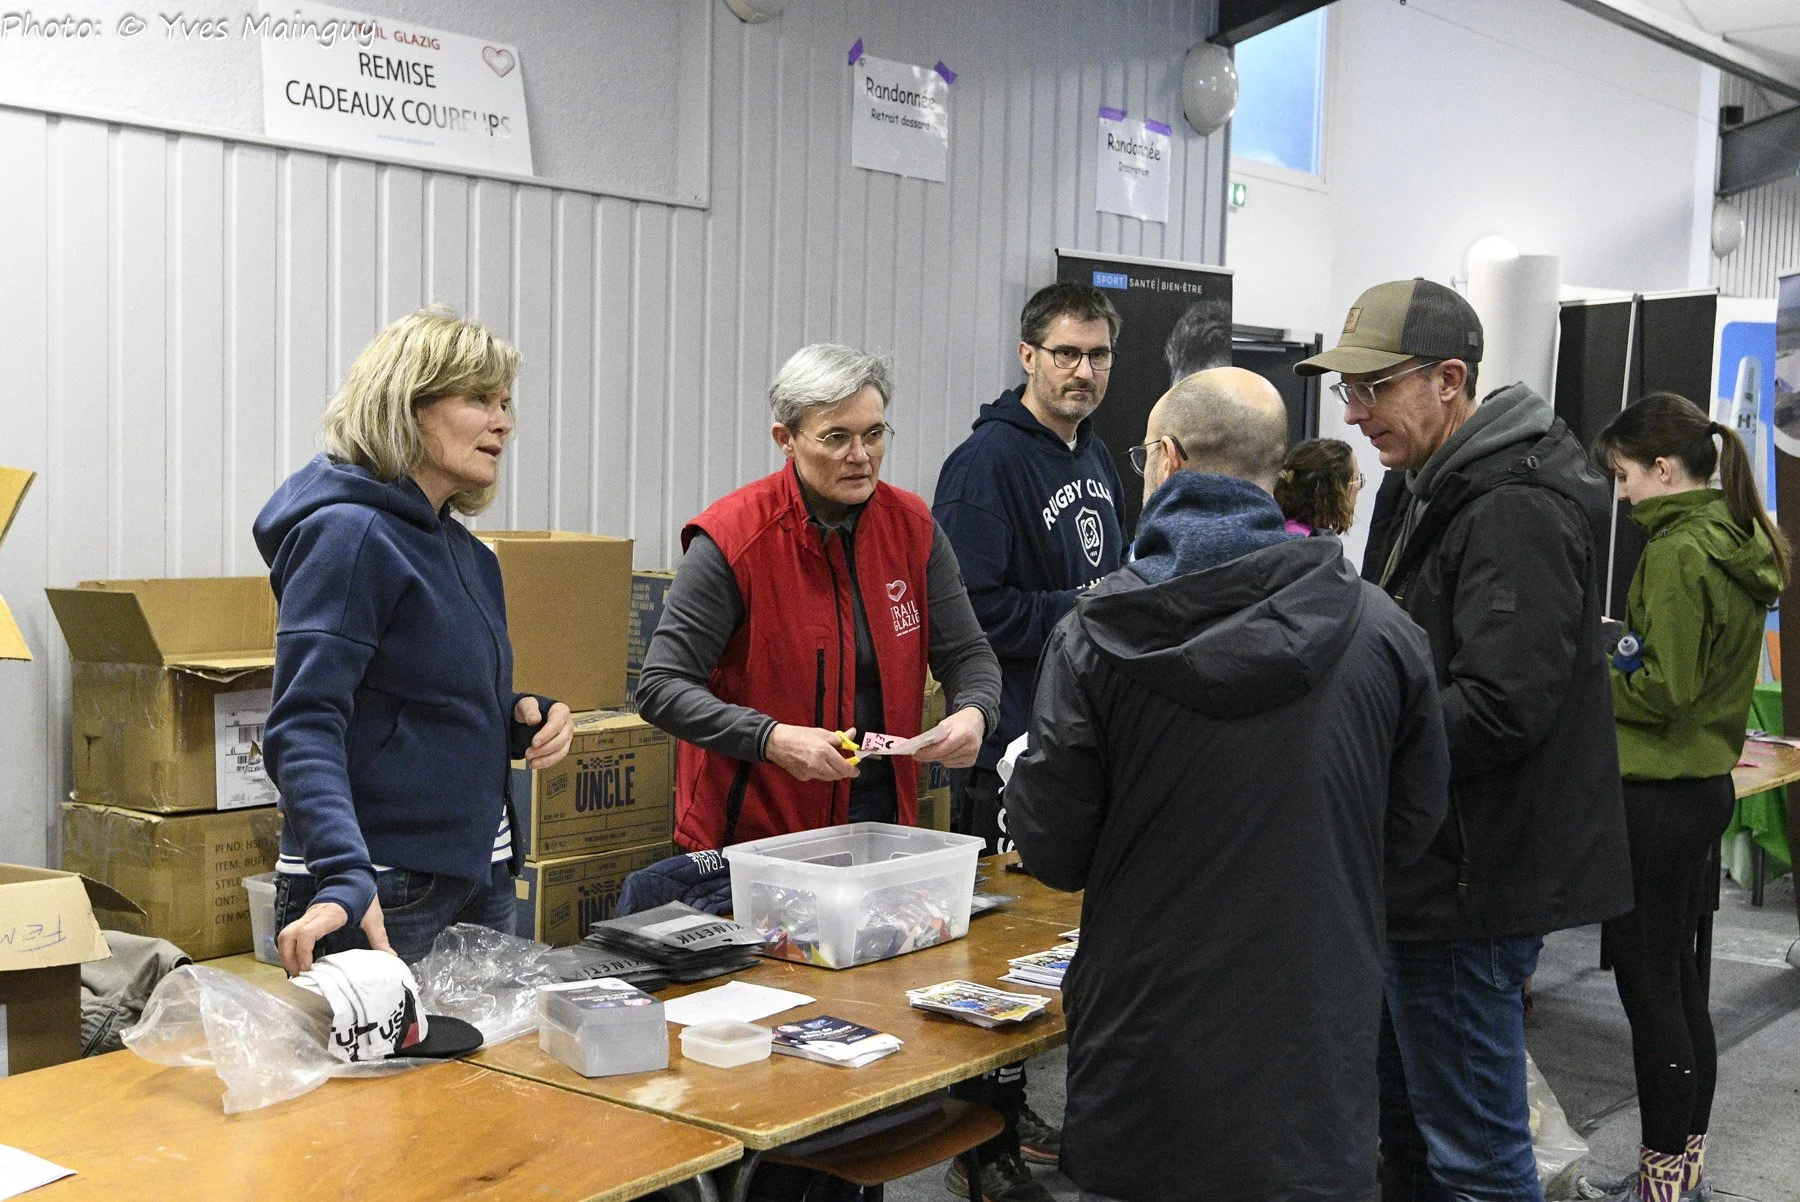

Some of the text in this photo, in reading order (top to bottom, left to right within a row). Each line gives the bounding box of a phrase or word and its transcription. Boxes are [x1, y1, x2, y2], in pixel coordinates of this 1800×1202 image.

[393, 30, 440, 51] GLAZIG
[358, 52, 437, 88] REMISE
[285, 80, 396, 120] CADEAUX
[866, 76, 937, 111] Randonnée
[1107, 132, 1161, 161] Randonnée
[1096, 273, 1123, 286] SPORT
[1128, 277, 1156, 290] SANTÉ
[1042, 478, 1114, 531] RUGBY CLU
[575, 765, 636, 813] UNCLE
